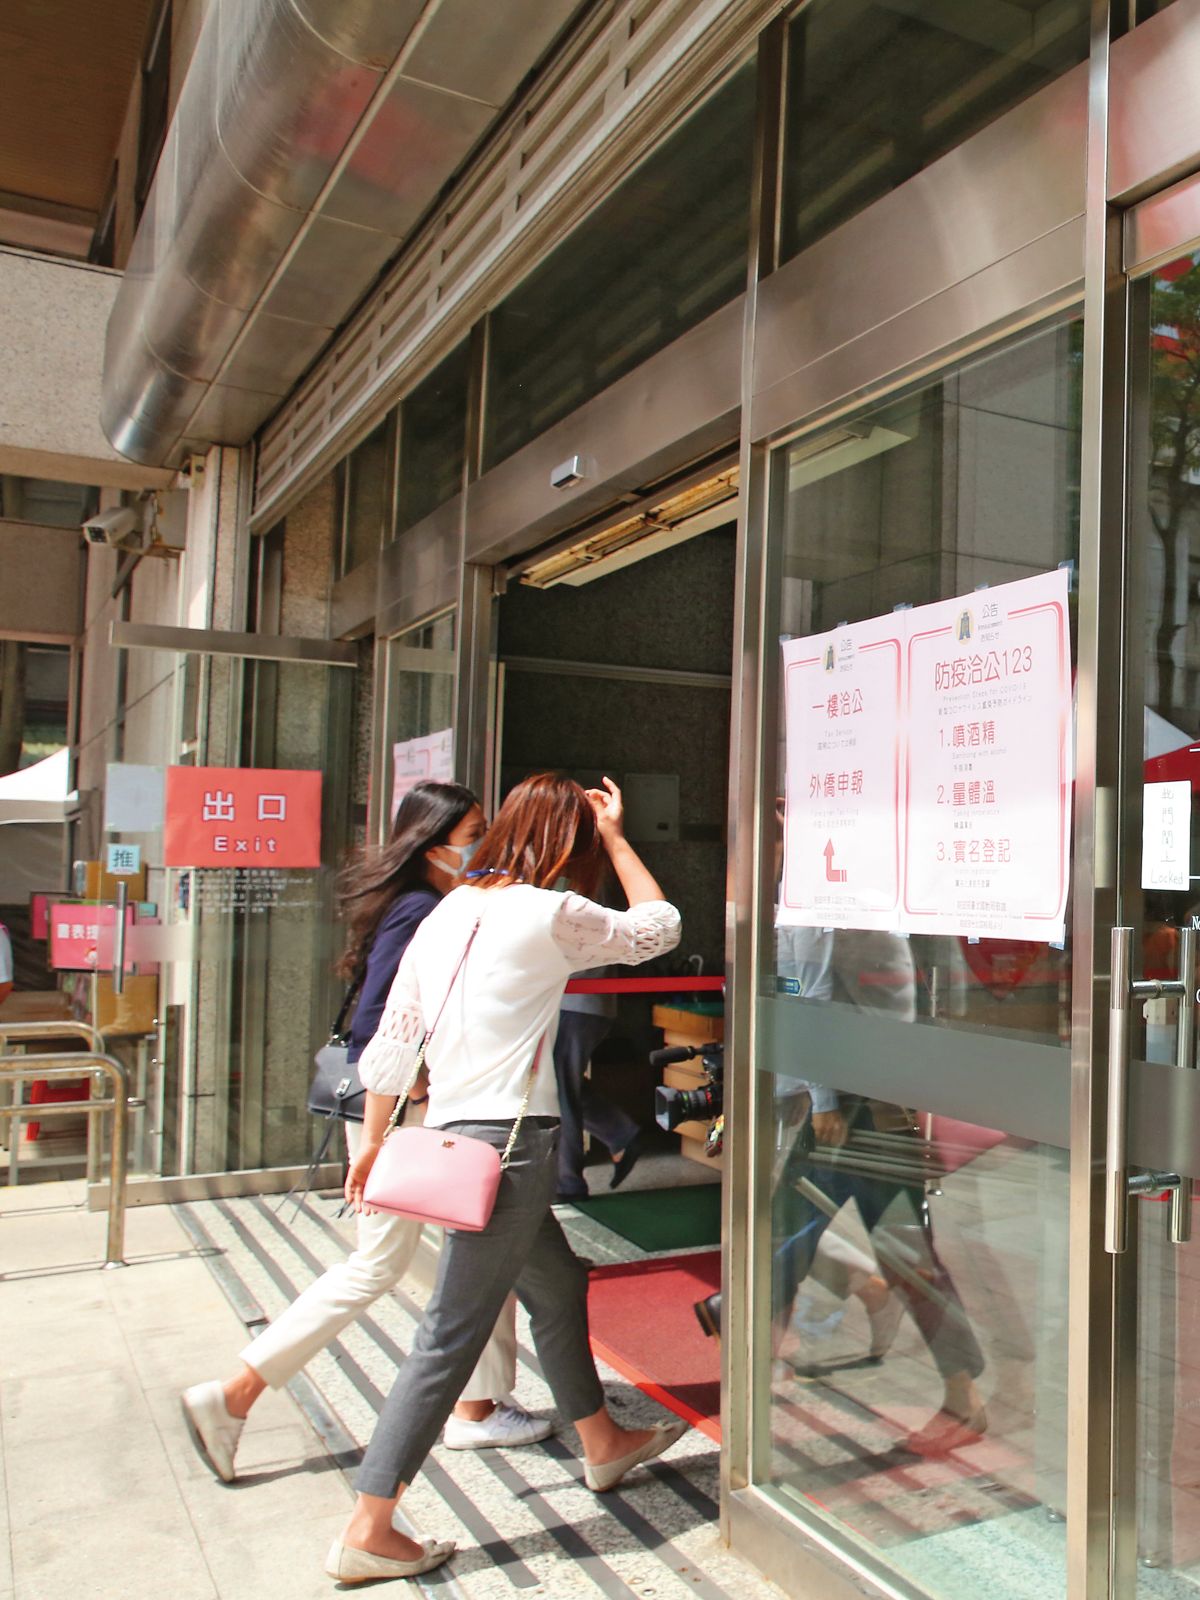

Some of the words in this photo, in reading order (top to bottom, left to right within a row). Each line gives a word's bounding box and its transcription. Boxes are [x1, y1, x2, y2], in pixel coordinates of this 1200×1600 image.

[935, 645, 1033, 691] 防疫洽公123
[812, 688, 863, 719] 一樓洽公
[809, 769, 863, 799] 外僑申報
[203, 789, 287, 822] 出口
[113, 848, 134, 868] 推
[213, 835, 277, 852] Exit
